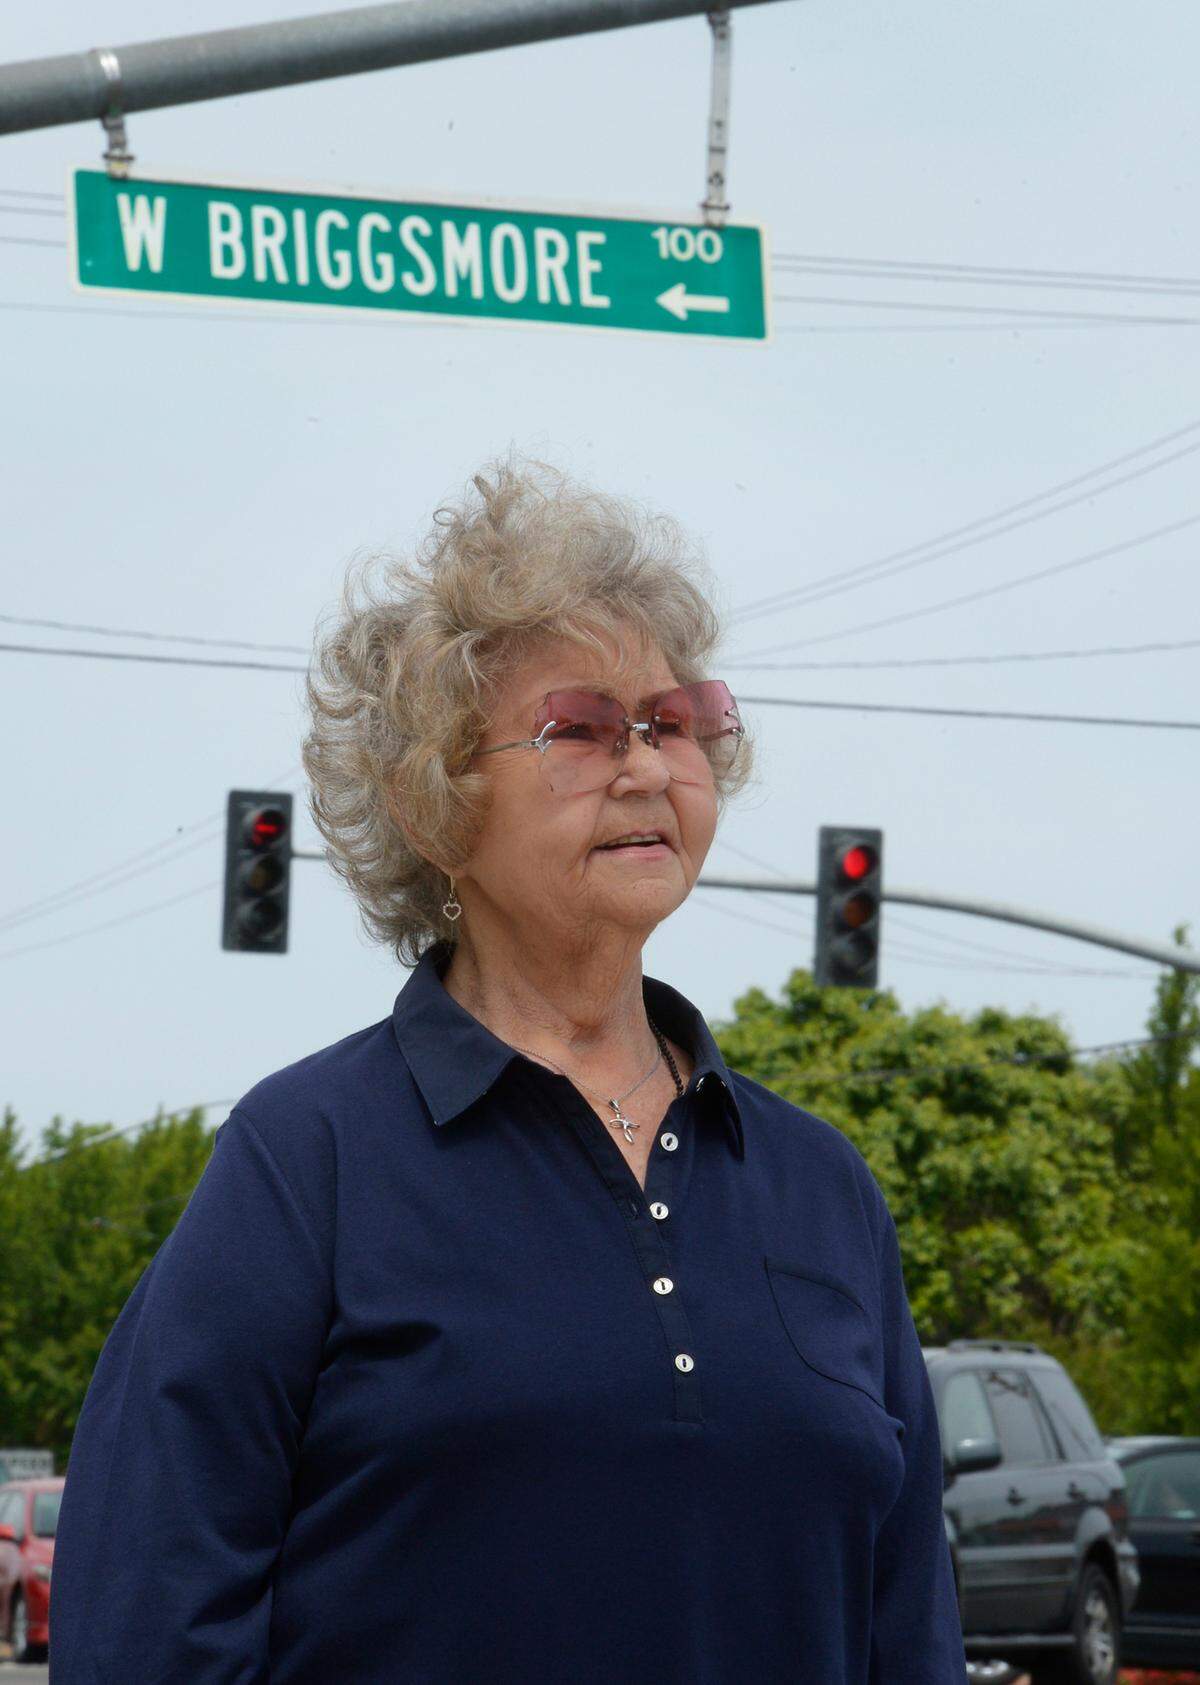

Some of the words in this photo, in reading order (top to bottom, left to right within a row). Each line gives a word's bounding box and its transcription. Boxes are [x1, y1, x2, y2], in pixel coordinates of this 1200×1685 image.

[117, 193, 167, 273] W
[208, 201, 611, 309] BRIGGSMORE
[651, 227, 723, 263] 100
